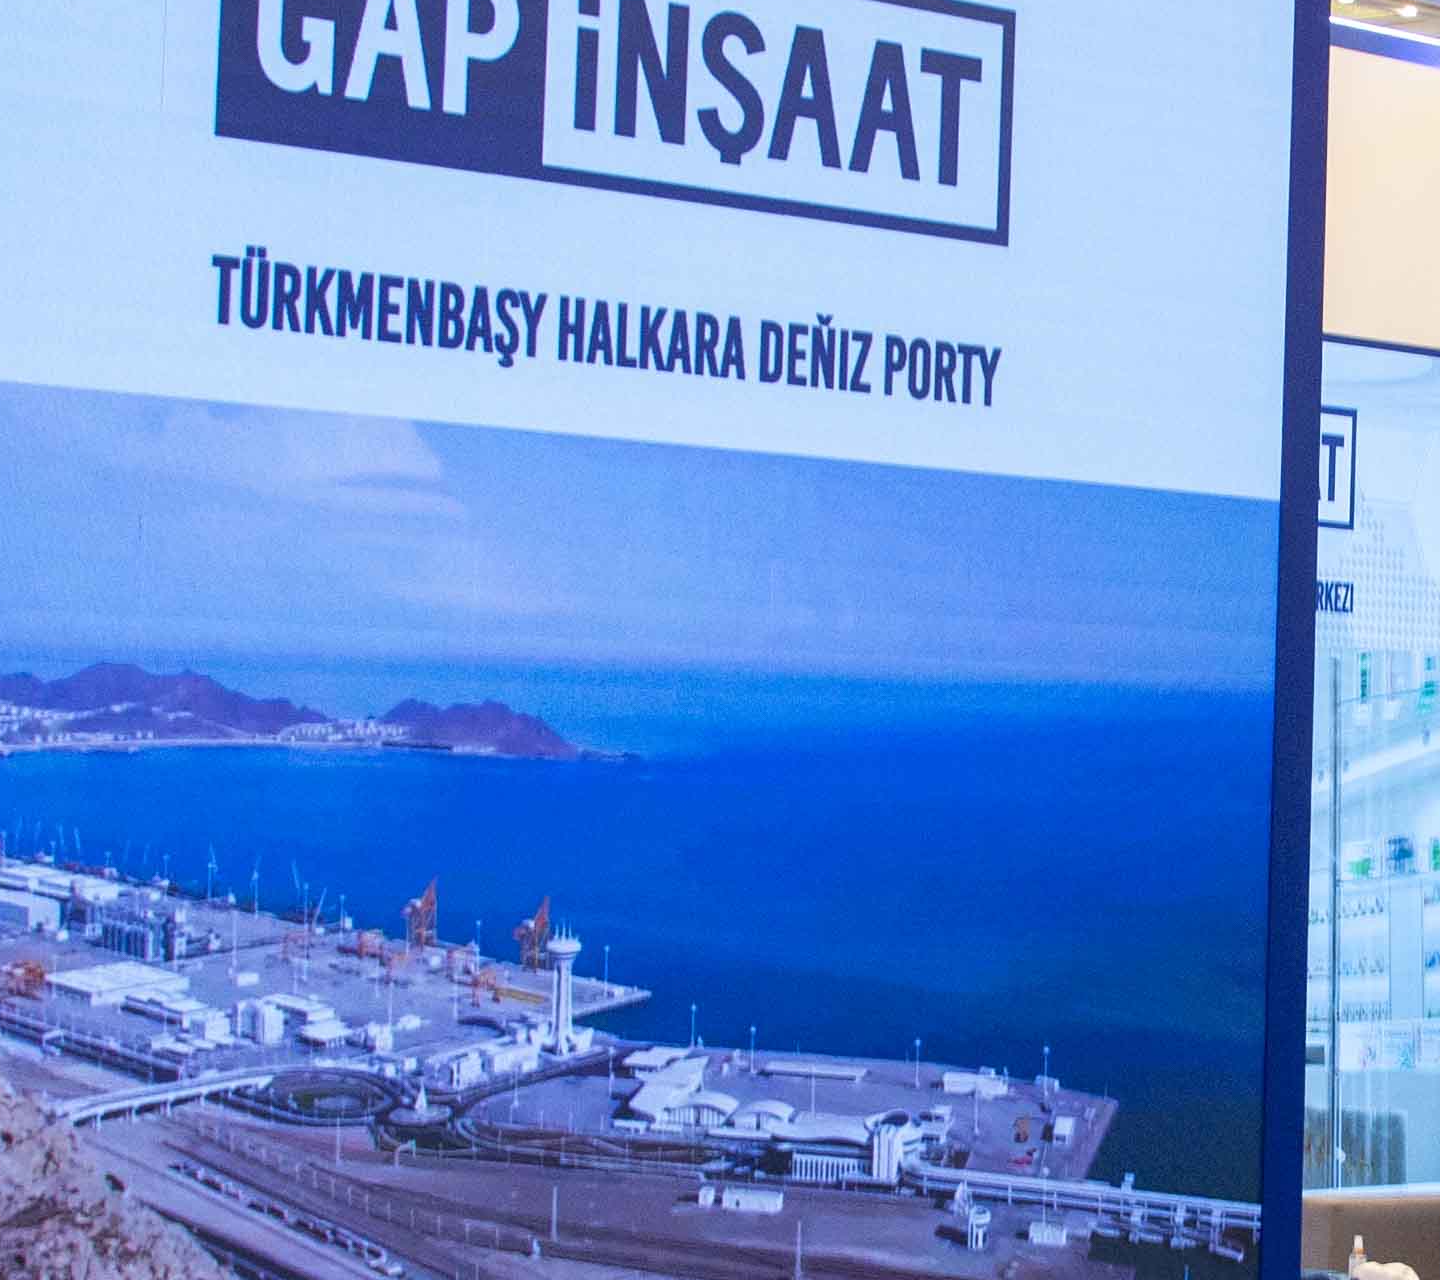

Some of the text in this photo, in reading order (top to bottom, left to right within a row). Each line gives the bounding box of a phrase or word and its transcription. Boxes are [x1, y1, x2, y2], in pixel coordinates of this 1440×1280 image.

[212, 246, 546, 367] TÜRKMENBAŞY
[559, 297, 745, 380] HALKARA
[883, 337, 1002, 407] PORTY
